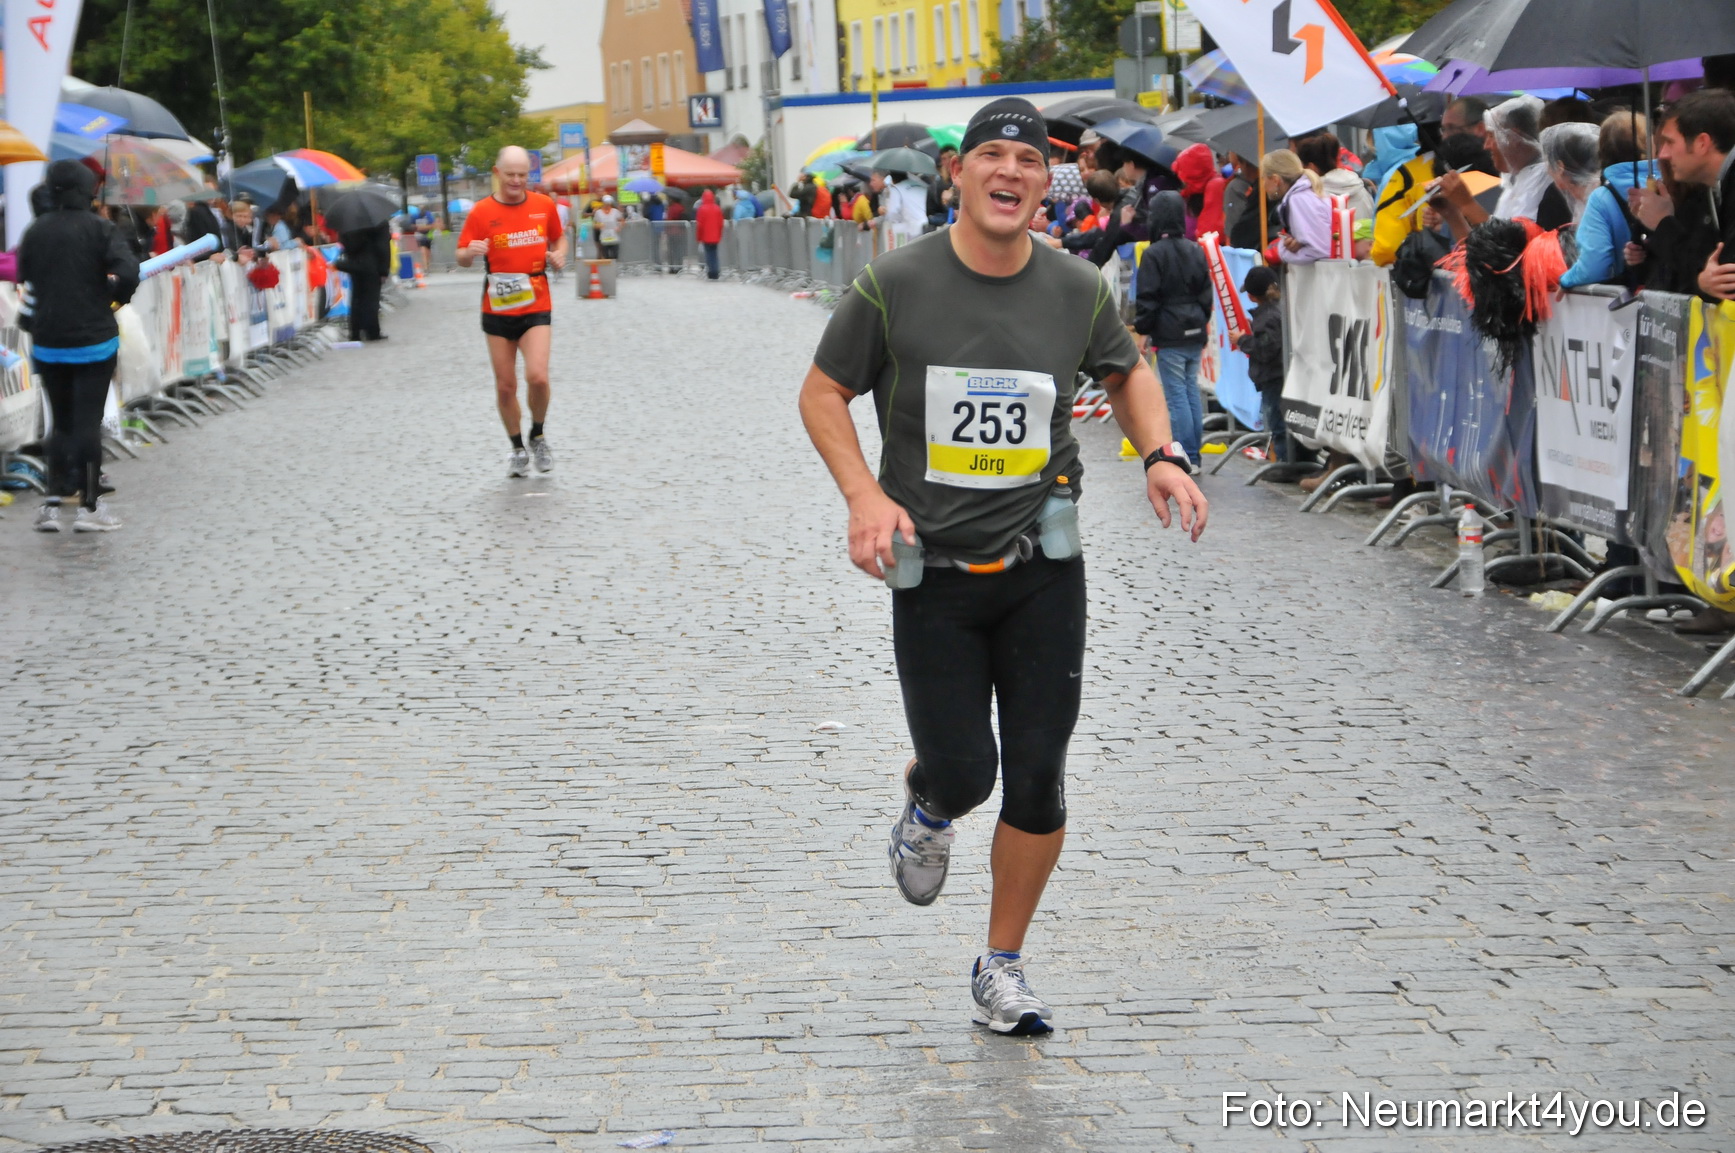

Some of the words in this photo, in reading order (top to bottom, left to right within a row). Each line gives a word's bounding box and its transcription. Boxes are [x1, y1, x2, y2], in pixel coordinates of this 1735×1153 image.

[967, 376, 1018, 390] BOCK
[951, 400, 1027, 445] 253
[969, 454, 1005, 475] Jörg
